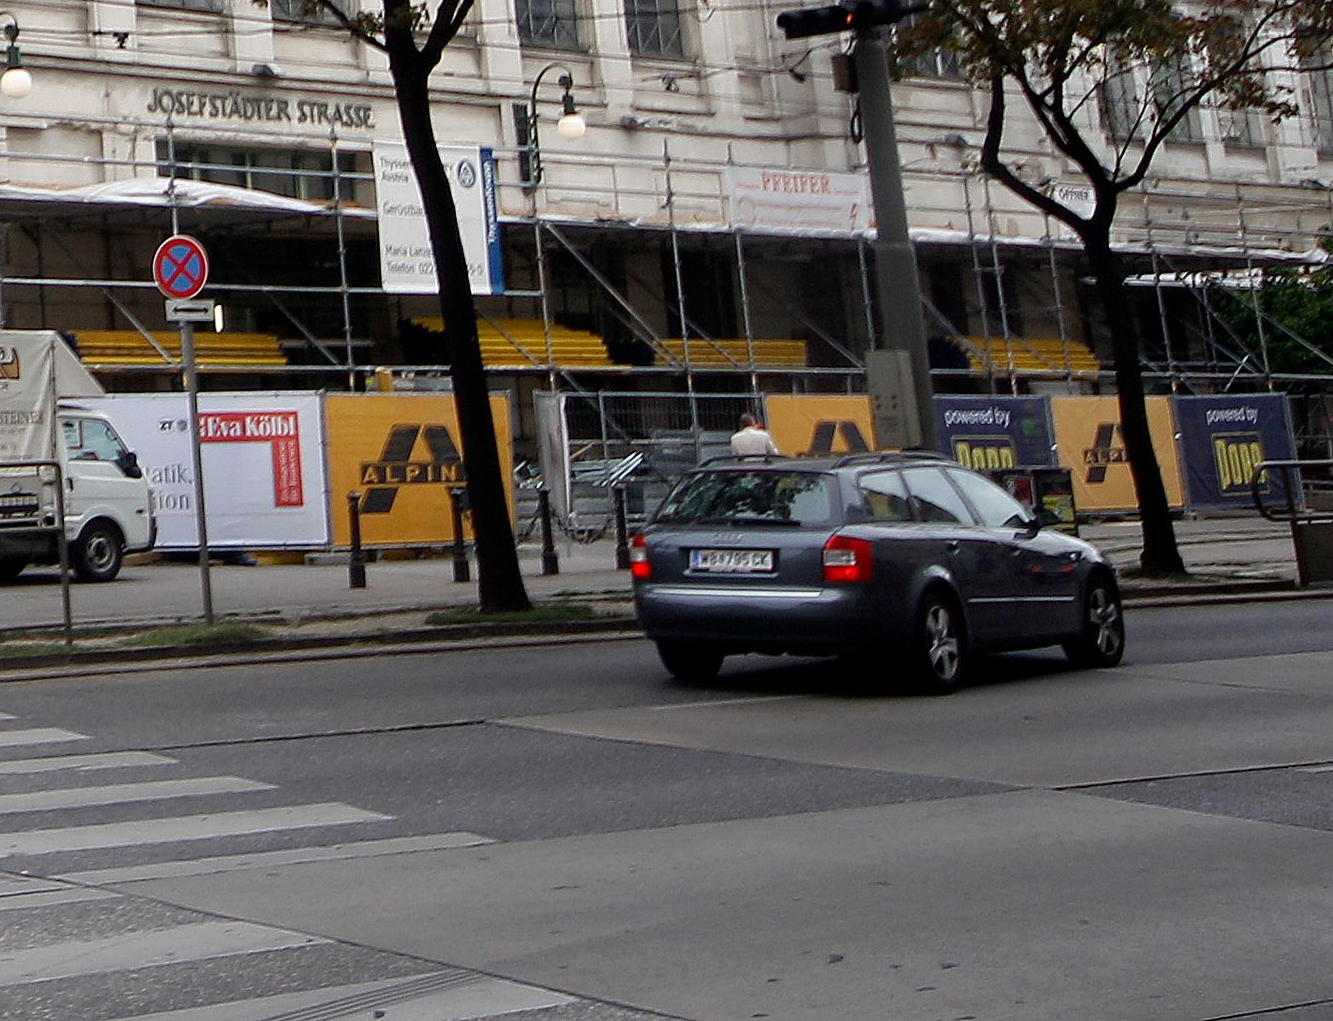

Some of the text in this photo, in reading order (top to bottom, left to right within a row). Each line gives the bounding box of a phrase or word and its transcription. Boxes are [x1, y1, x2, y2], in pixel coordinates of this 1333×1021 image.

[147, 87, 375, 129] JOSEFSTÄDTER STRASSE
[383, 201, 426, 217] Gerüstba
[207, 415, 295, 436] Eva Kölbl
[944, 407, 1011, 427] powered by
[1206, 407, 1258, 426] powered by
[363, 464, 456, 483] ALPIN
[158, 490, 189, 510] ion
